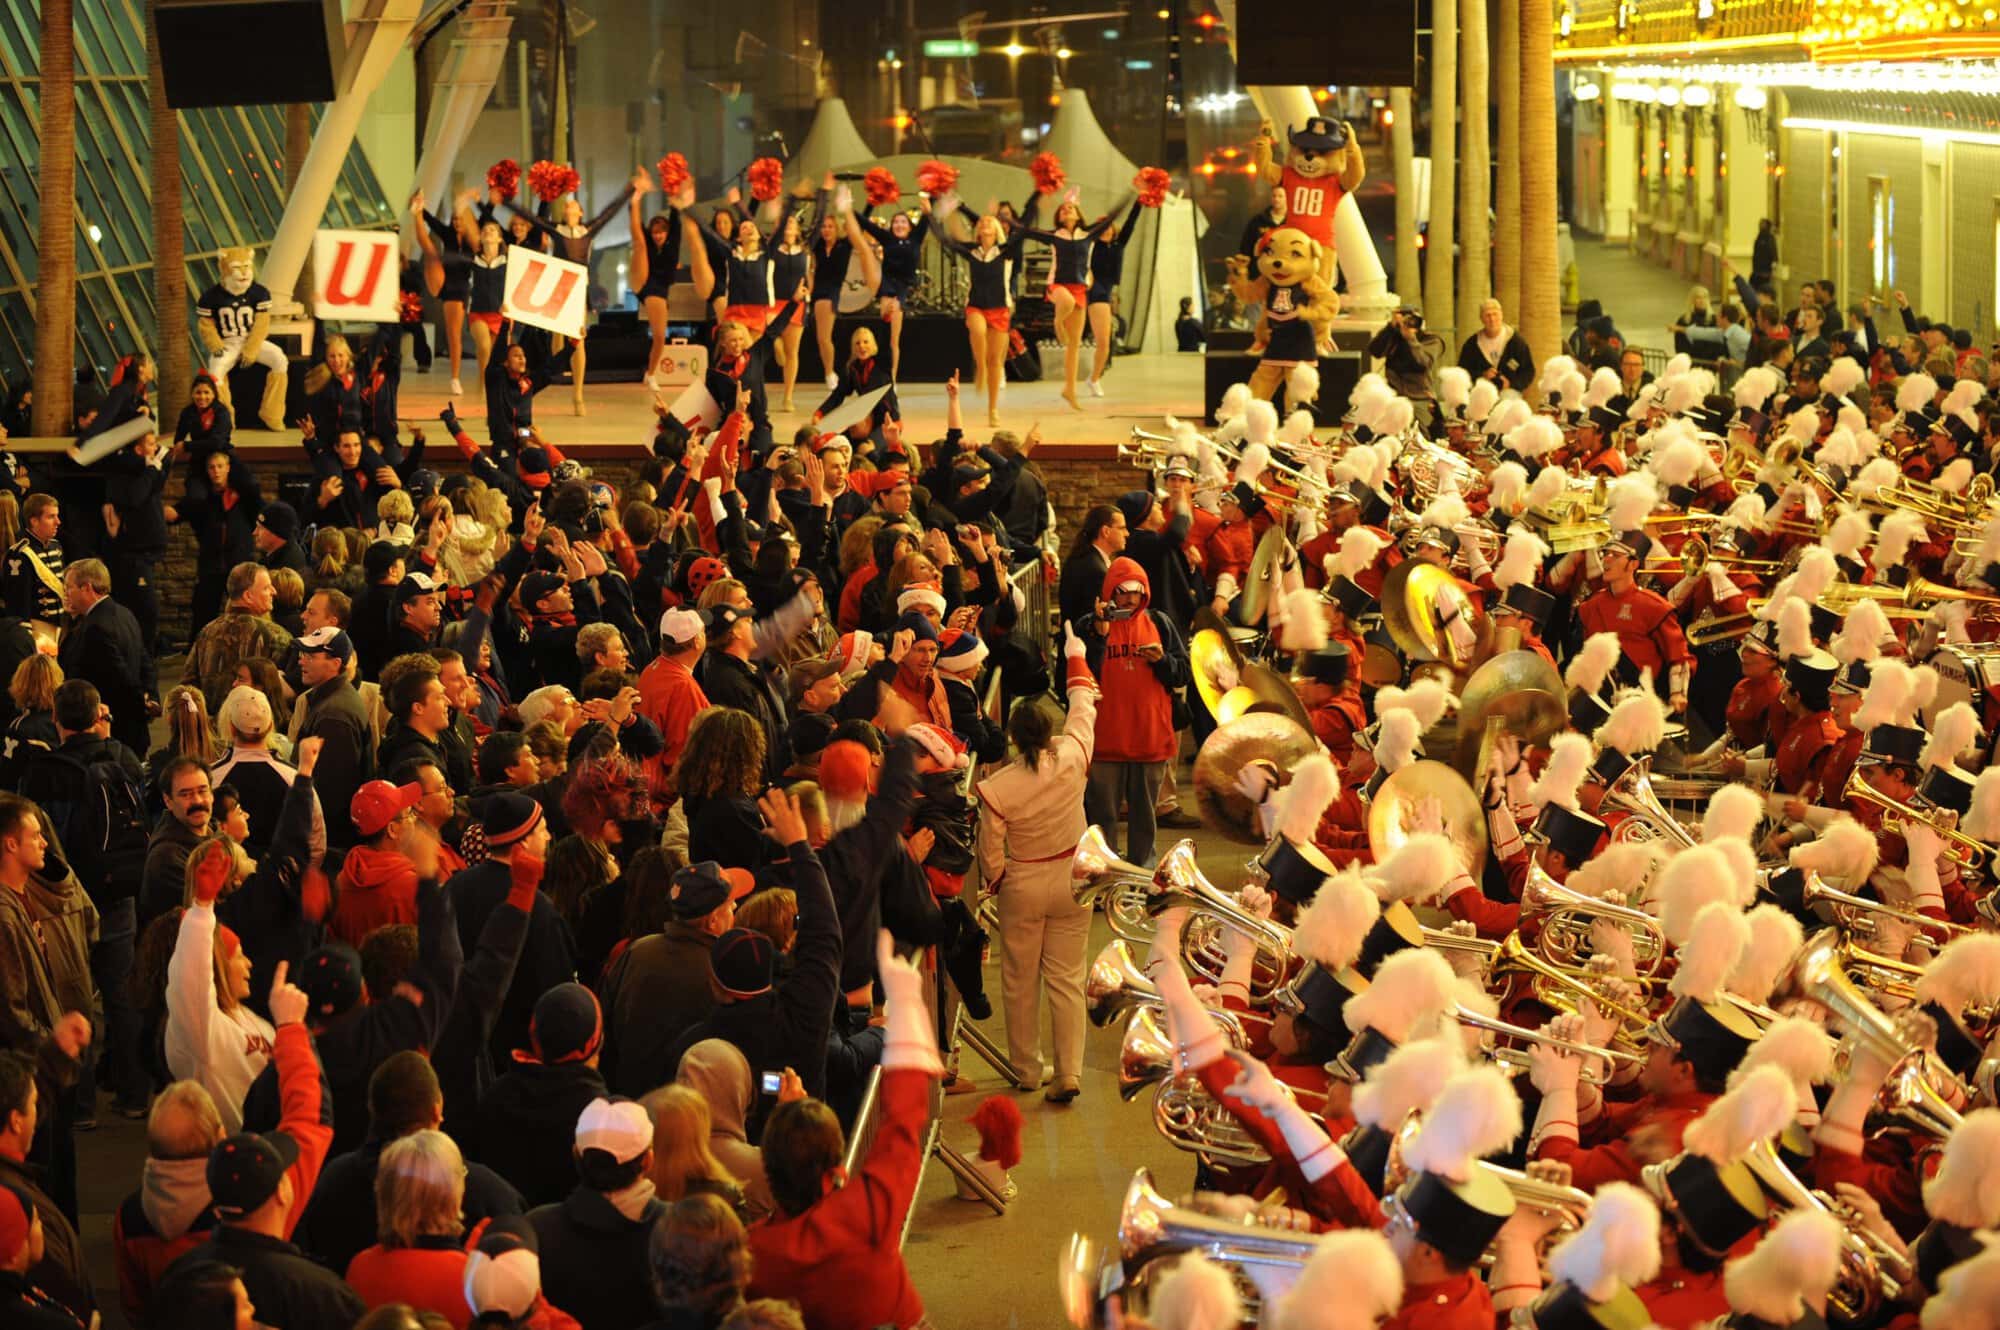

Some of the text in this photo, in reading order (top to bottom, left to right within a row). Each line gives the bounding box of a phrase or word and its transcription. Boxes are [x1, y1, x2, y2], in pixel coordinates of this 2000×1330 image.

[1293, 186, 1323, 216] 08
[326, 241, 391, 307] U
[511, 259, 580, 321] U
[218, 306, 254, 338] 00
[8, 558, 23, 576] Y
